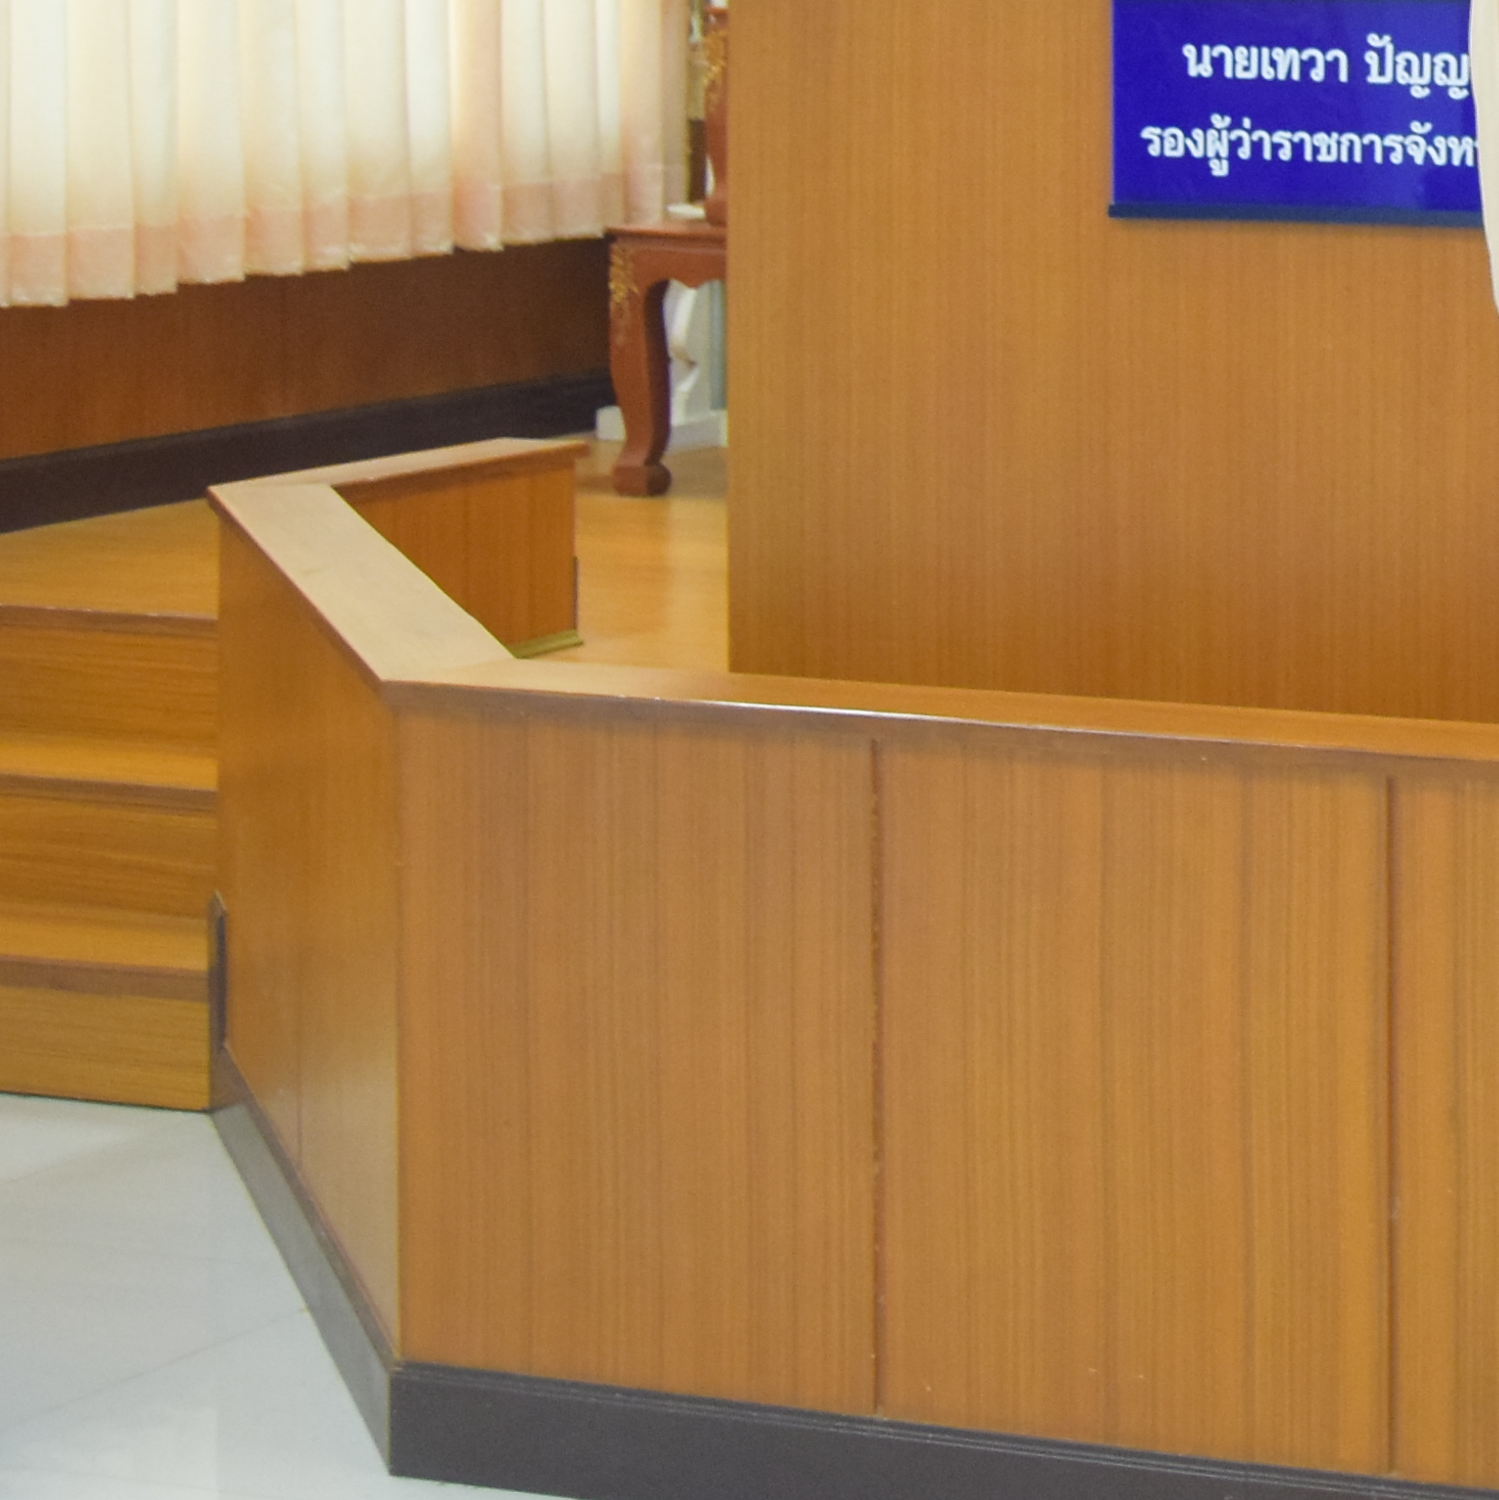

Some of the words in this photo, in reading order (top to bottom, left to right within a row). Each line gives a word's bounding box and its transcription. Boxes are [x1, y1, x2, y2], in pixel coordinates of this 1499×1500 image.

[1182, 43, 1349, 83] นายเทวา
[1364, 32, 1470, 100] ปัญญ
[1140, 112, 1479, 177] รองผู้ว่าราชการจังห
